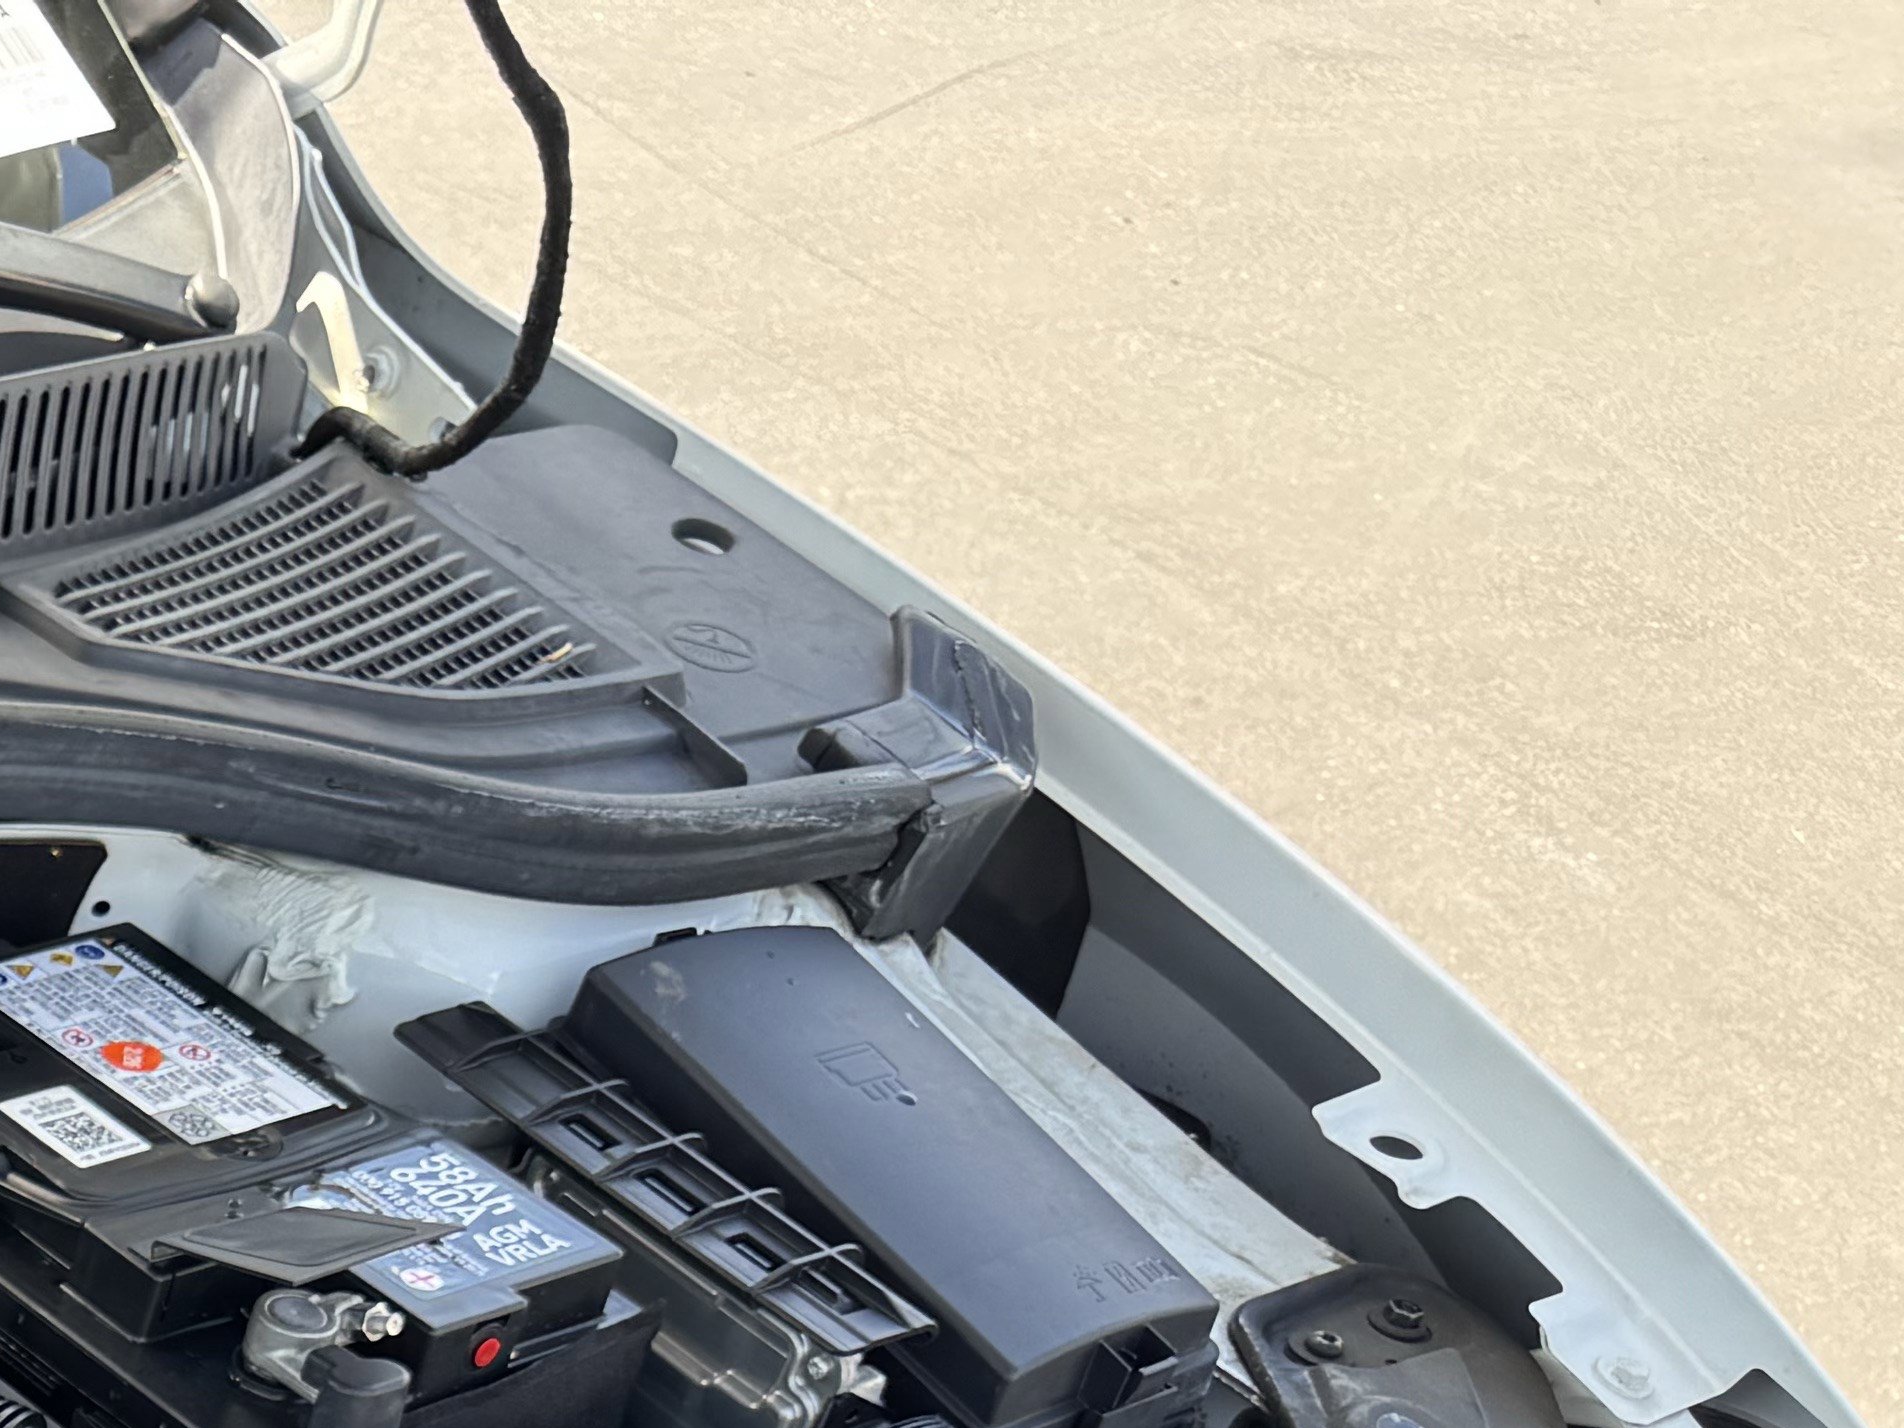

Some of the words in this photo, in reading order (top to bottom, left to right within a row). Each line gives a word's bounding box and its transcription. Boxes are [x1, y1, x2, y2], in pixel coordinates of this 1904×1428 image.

[390, 1164, 486, 1227] 640A
[418, 1150, 517, 1215] 58Ah
[473, 1217, 542, 1256] AGM
[484, 1230, 575, 1270] VRLA
